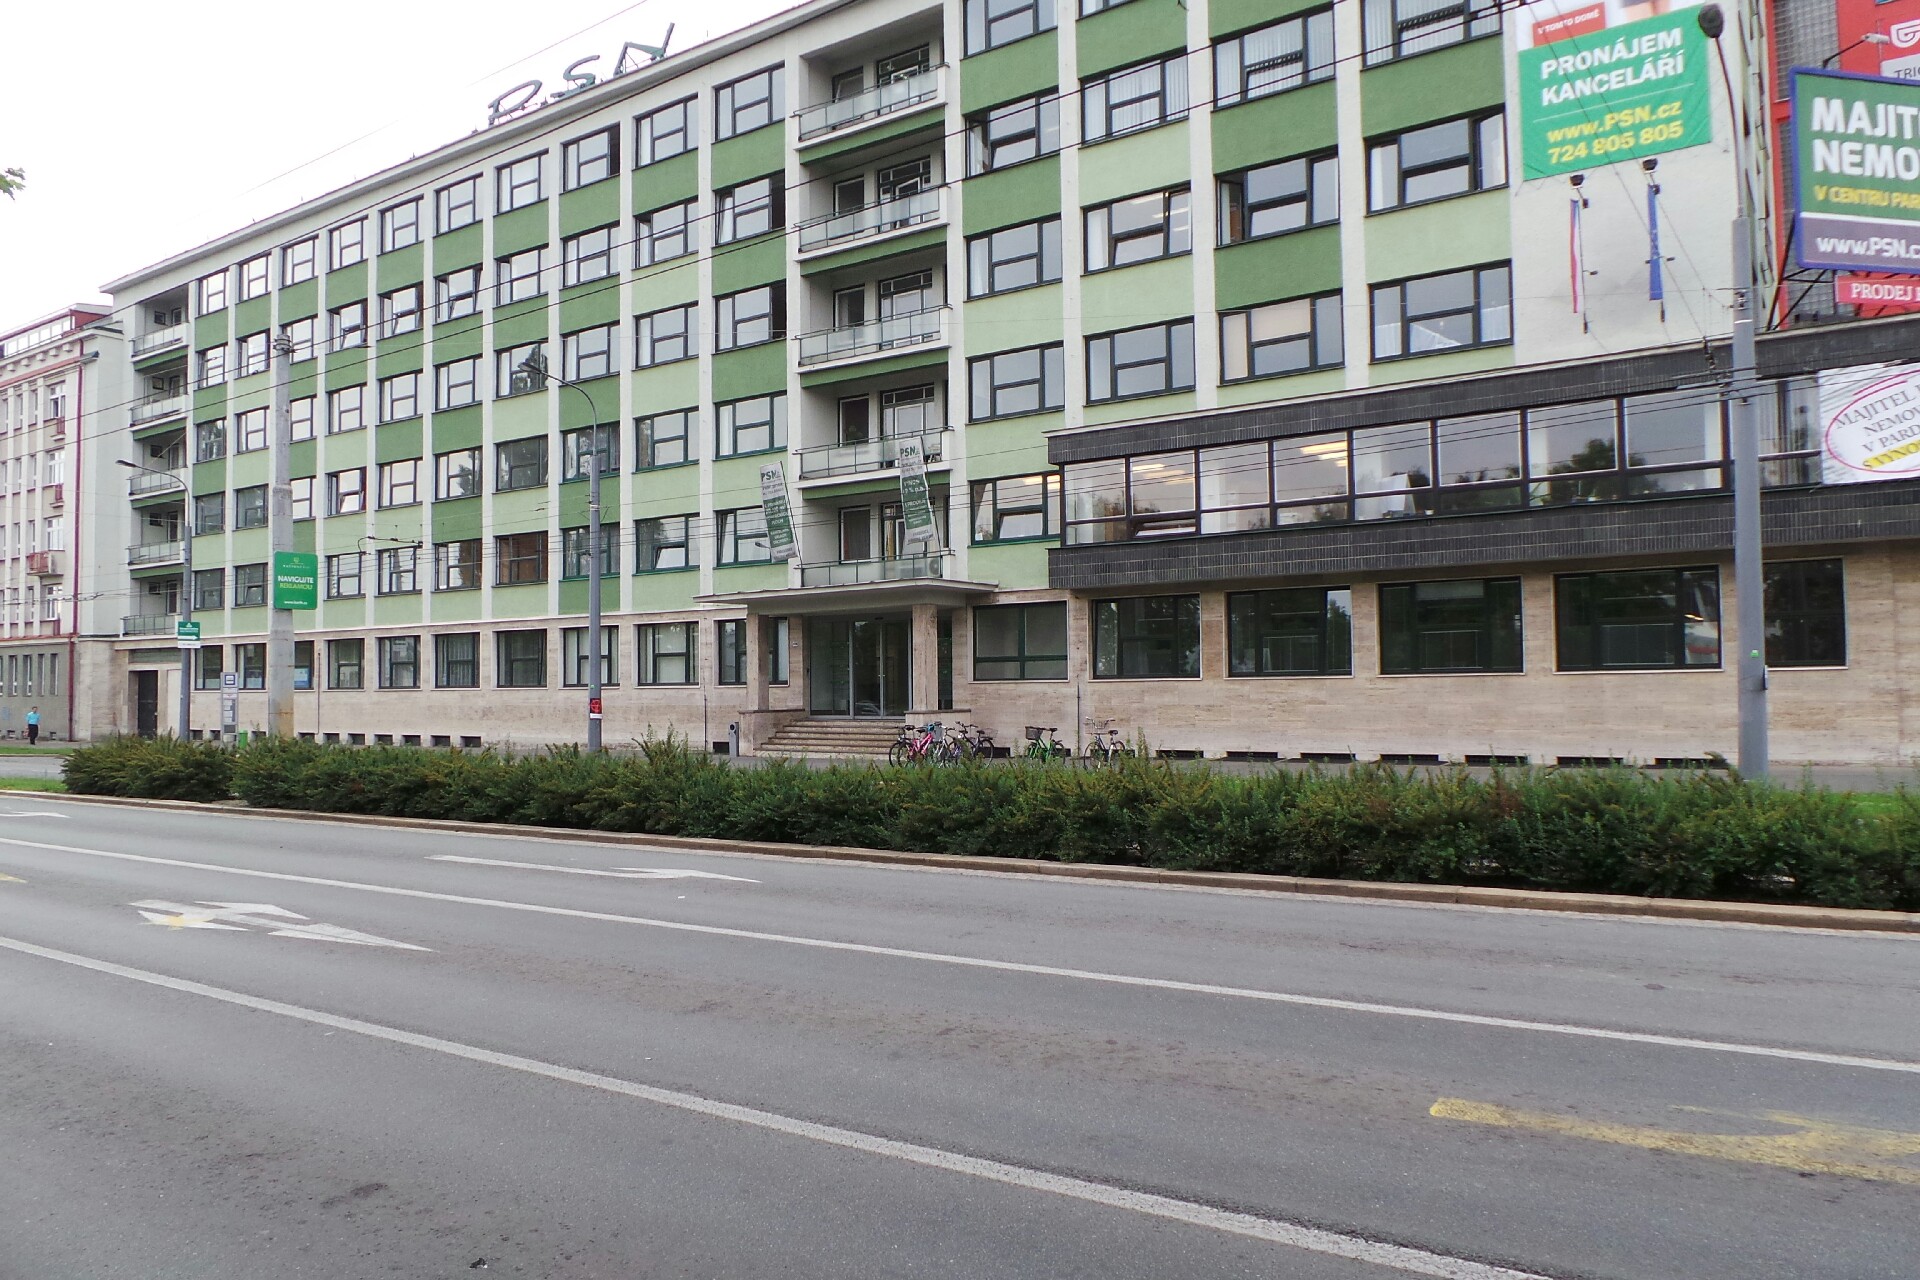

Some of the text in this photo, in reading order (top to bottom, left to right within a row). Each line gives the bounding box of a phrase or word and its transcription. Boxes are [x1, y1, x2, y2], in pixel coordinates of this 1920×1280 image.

[1540, 27, 1683, 79] PRONÁJEM
[1893, 66, 1920, 79] TRI
[1541, 49, 1685, 106] KANCELÁŘÍ
[1546, 101, 1683, 143] www.PSN.cz
[1811, 96, 1920, 140] MAJIT
[1548, 120, 1684, 164] 724 805 805
[1813, 138, 1920, 181] NEMO
[1813, 185, 1828, 201] V
[1829, 186, 1890, 207] CENTRU
[1851, 282, 1913, 301] PRODEJ
[1833, 390, 1916, 430] MAJITEL
[900, 445, 916, 457] PSN
[761, 469, 777, 482] PSN
